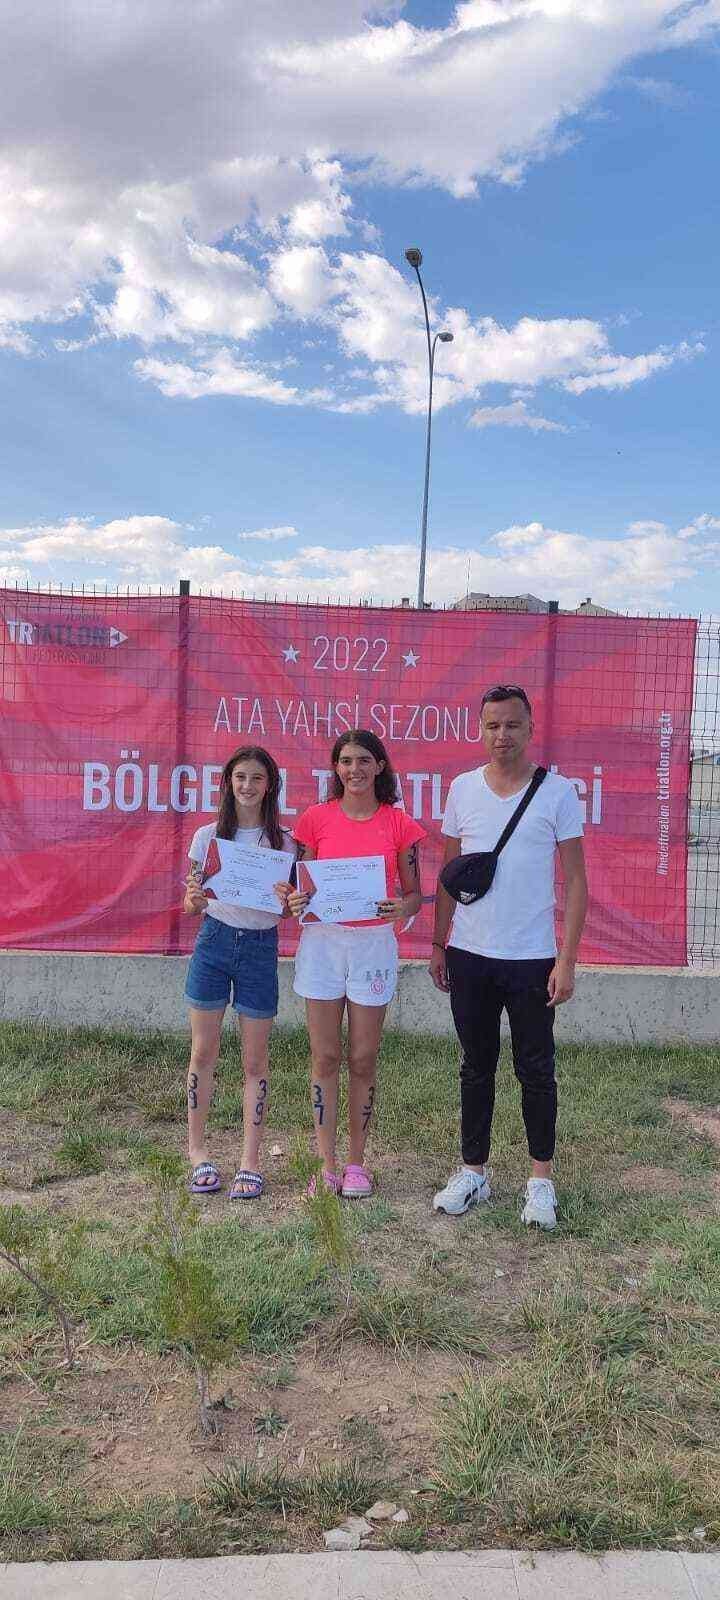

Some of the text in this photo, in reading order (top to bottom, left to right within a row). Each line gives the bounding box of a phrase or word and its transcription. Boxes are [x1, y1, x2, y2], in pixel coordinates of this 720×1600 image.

[312, 635, 389, 672] 2022
[213, 697, 266, 735] ATA
[369, 703, 482, 743] SEZONU
[656, 712, 673, 801] triatlon.org.tr
[83, 749, 297, 816] BÖLGEL
[253, 1079, 267, 1125] 39
[313, 1085, 324, 1125] 37
